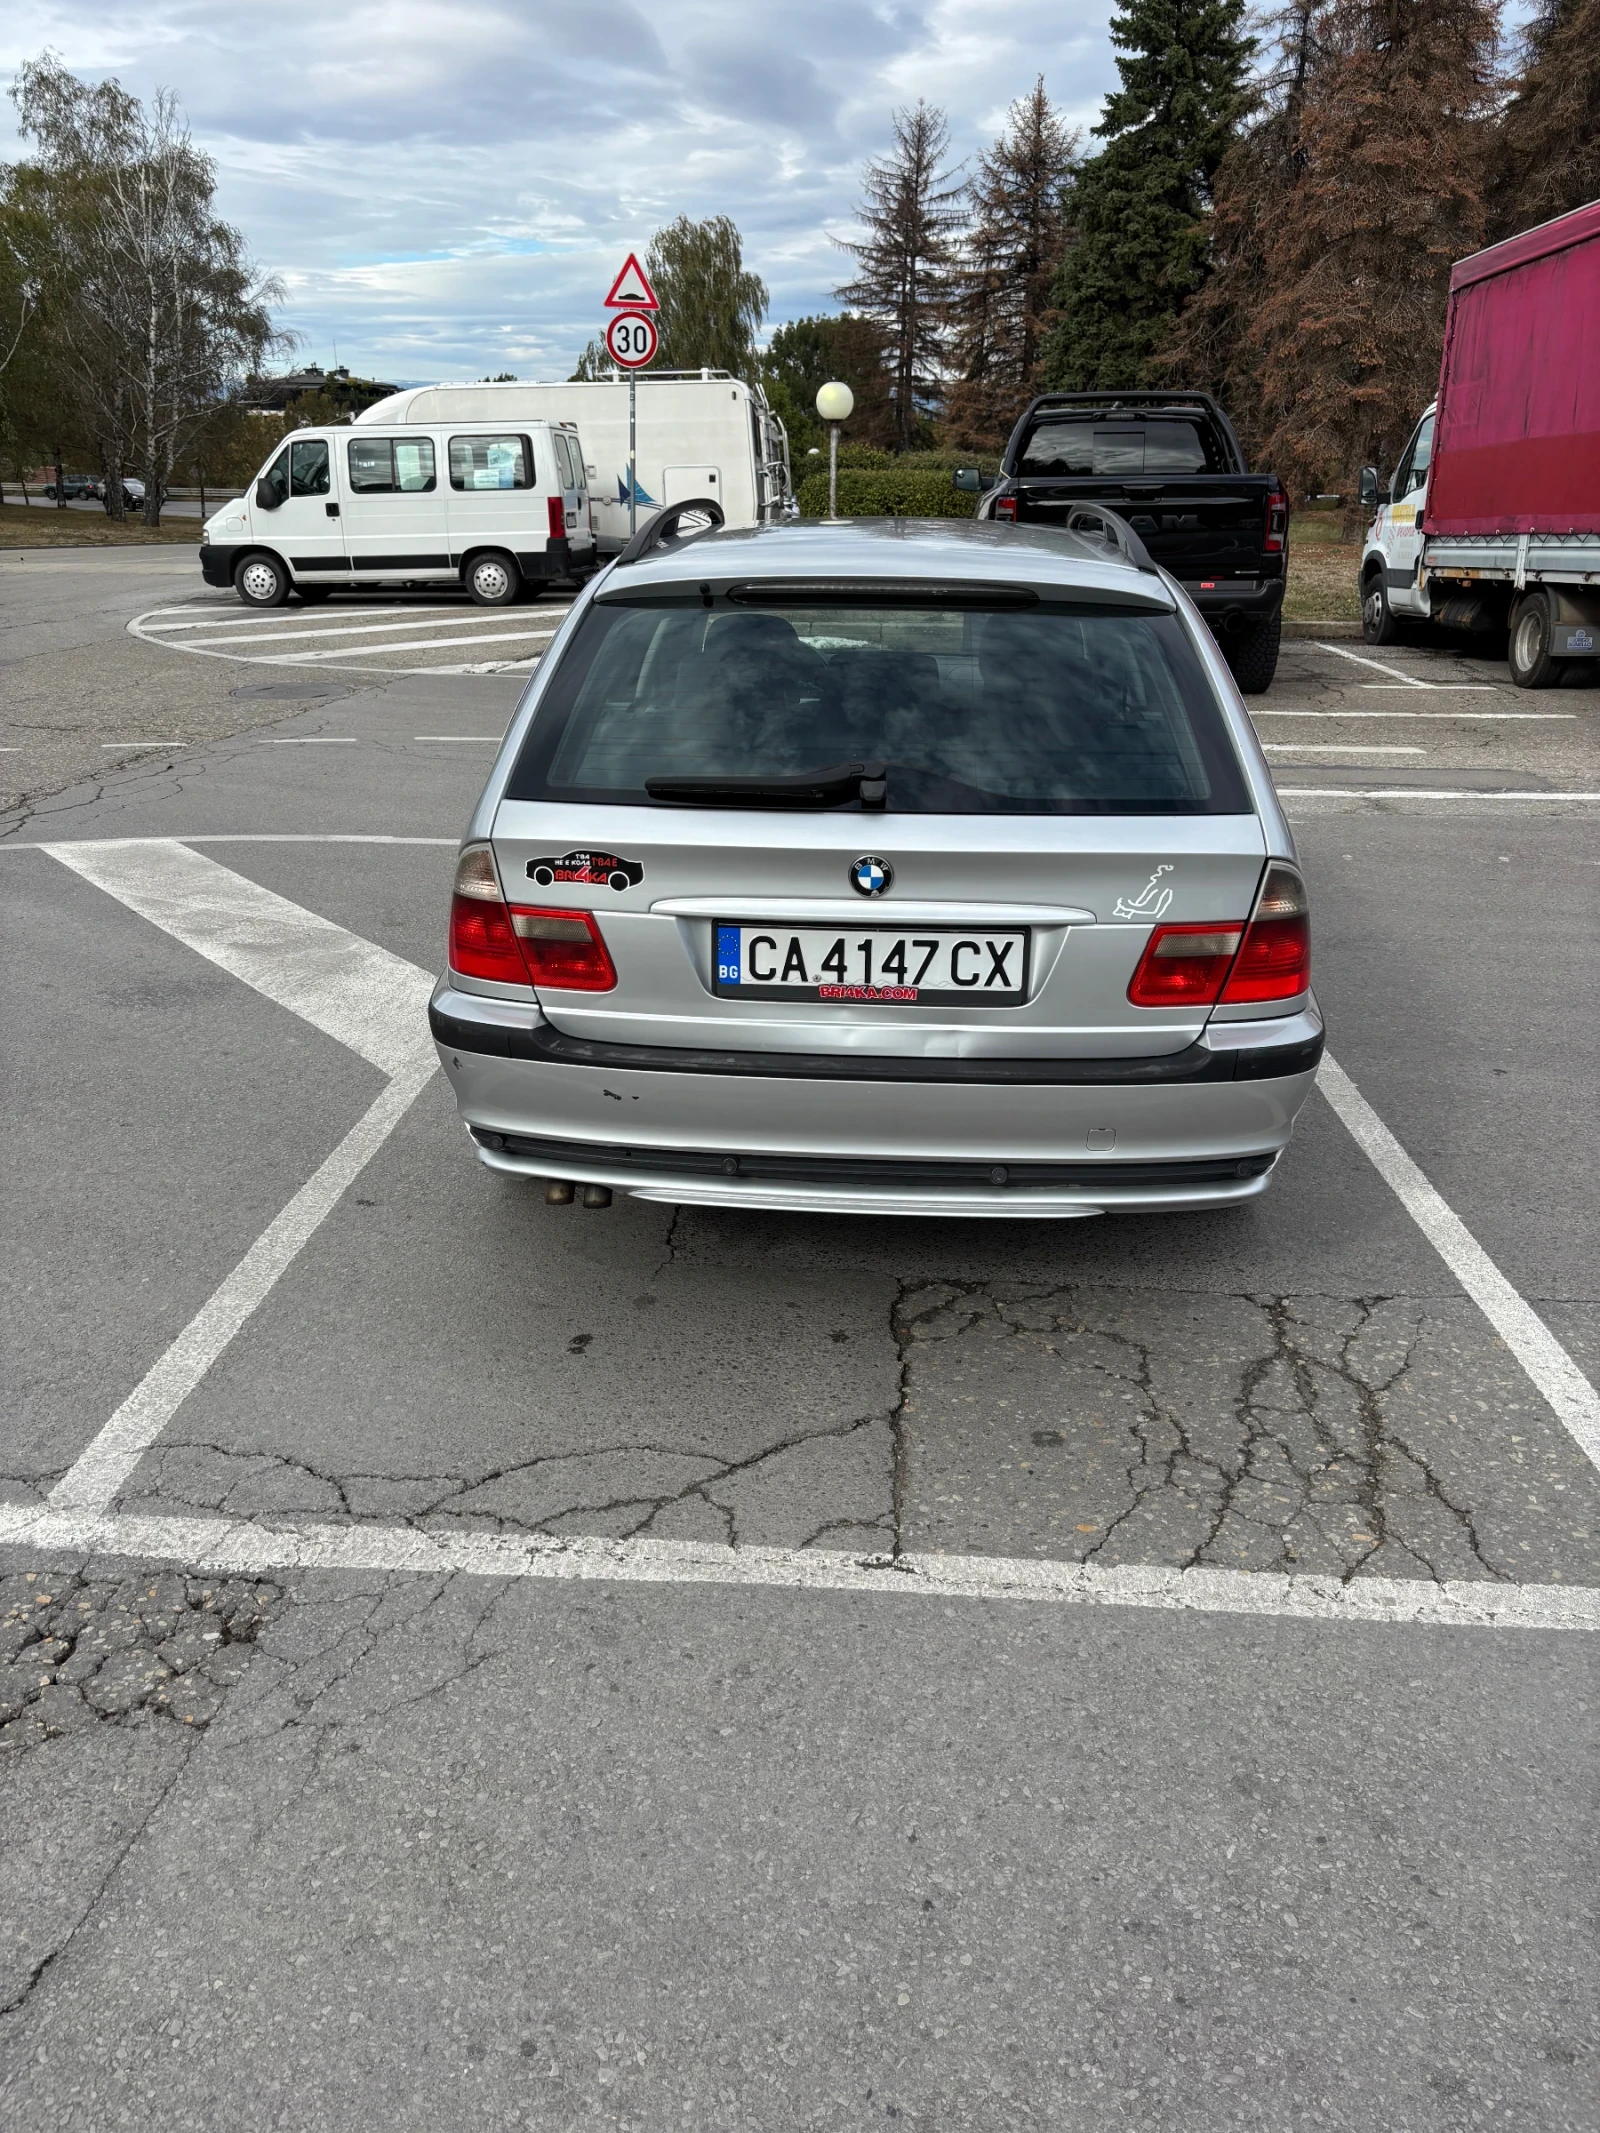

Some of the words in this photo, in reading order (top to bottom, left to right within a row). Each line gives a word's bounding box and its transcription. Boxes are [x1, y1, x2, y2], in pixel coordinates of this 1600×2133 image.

[617, 325, 647, 354] 30
[854, 857, 889, 871] BMW
[555, 866, 607, 883] BRI4KA
[749, 935, 809, 982] CA
[821, 938, 940, 985] 4147
[951, 941, 1014, 987] CX
[719, 965, 739, 979] BG
[819, 985, 918, 1001] BRI4KA.COM
